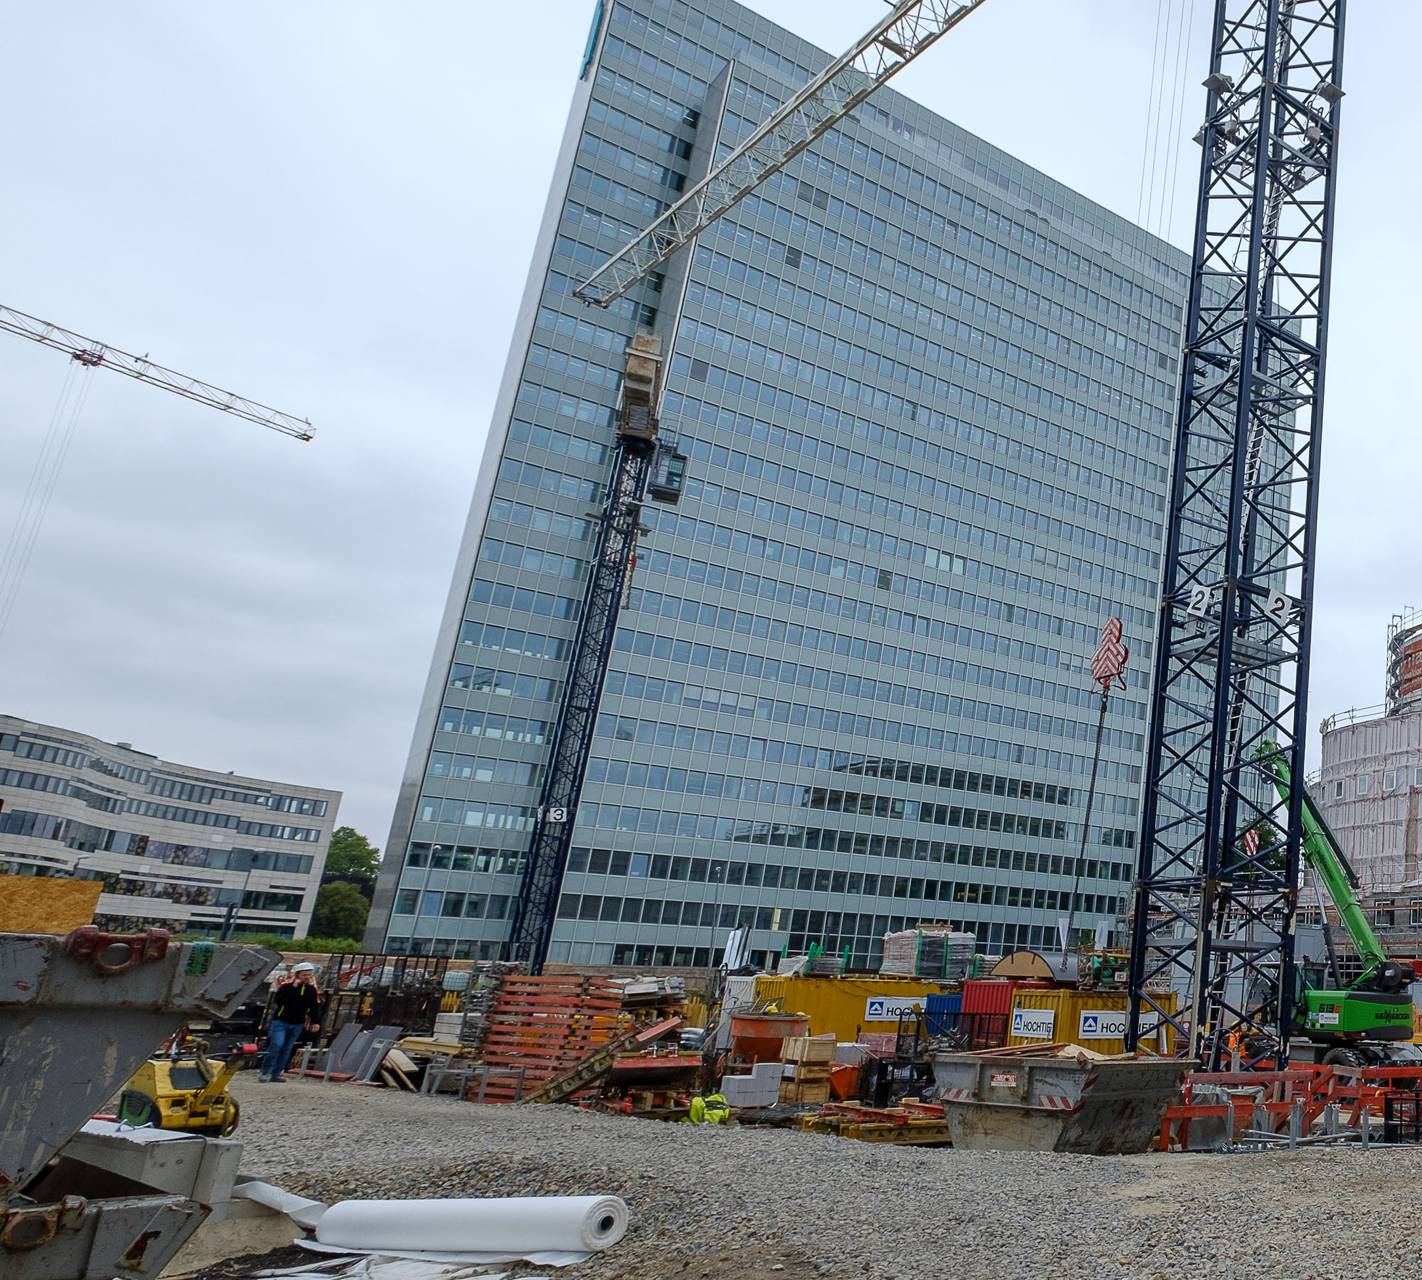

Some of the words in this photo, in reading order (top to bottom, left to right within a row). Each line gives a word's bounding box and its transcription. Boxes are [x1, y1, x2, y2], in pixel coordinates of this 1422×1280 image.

[1192, 590, 1205, 610] 2
[1270, 597, 1285, 619] 2
[553, 808, 564, 821] 3
